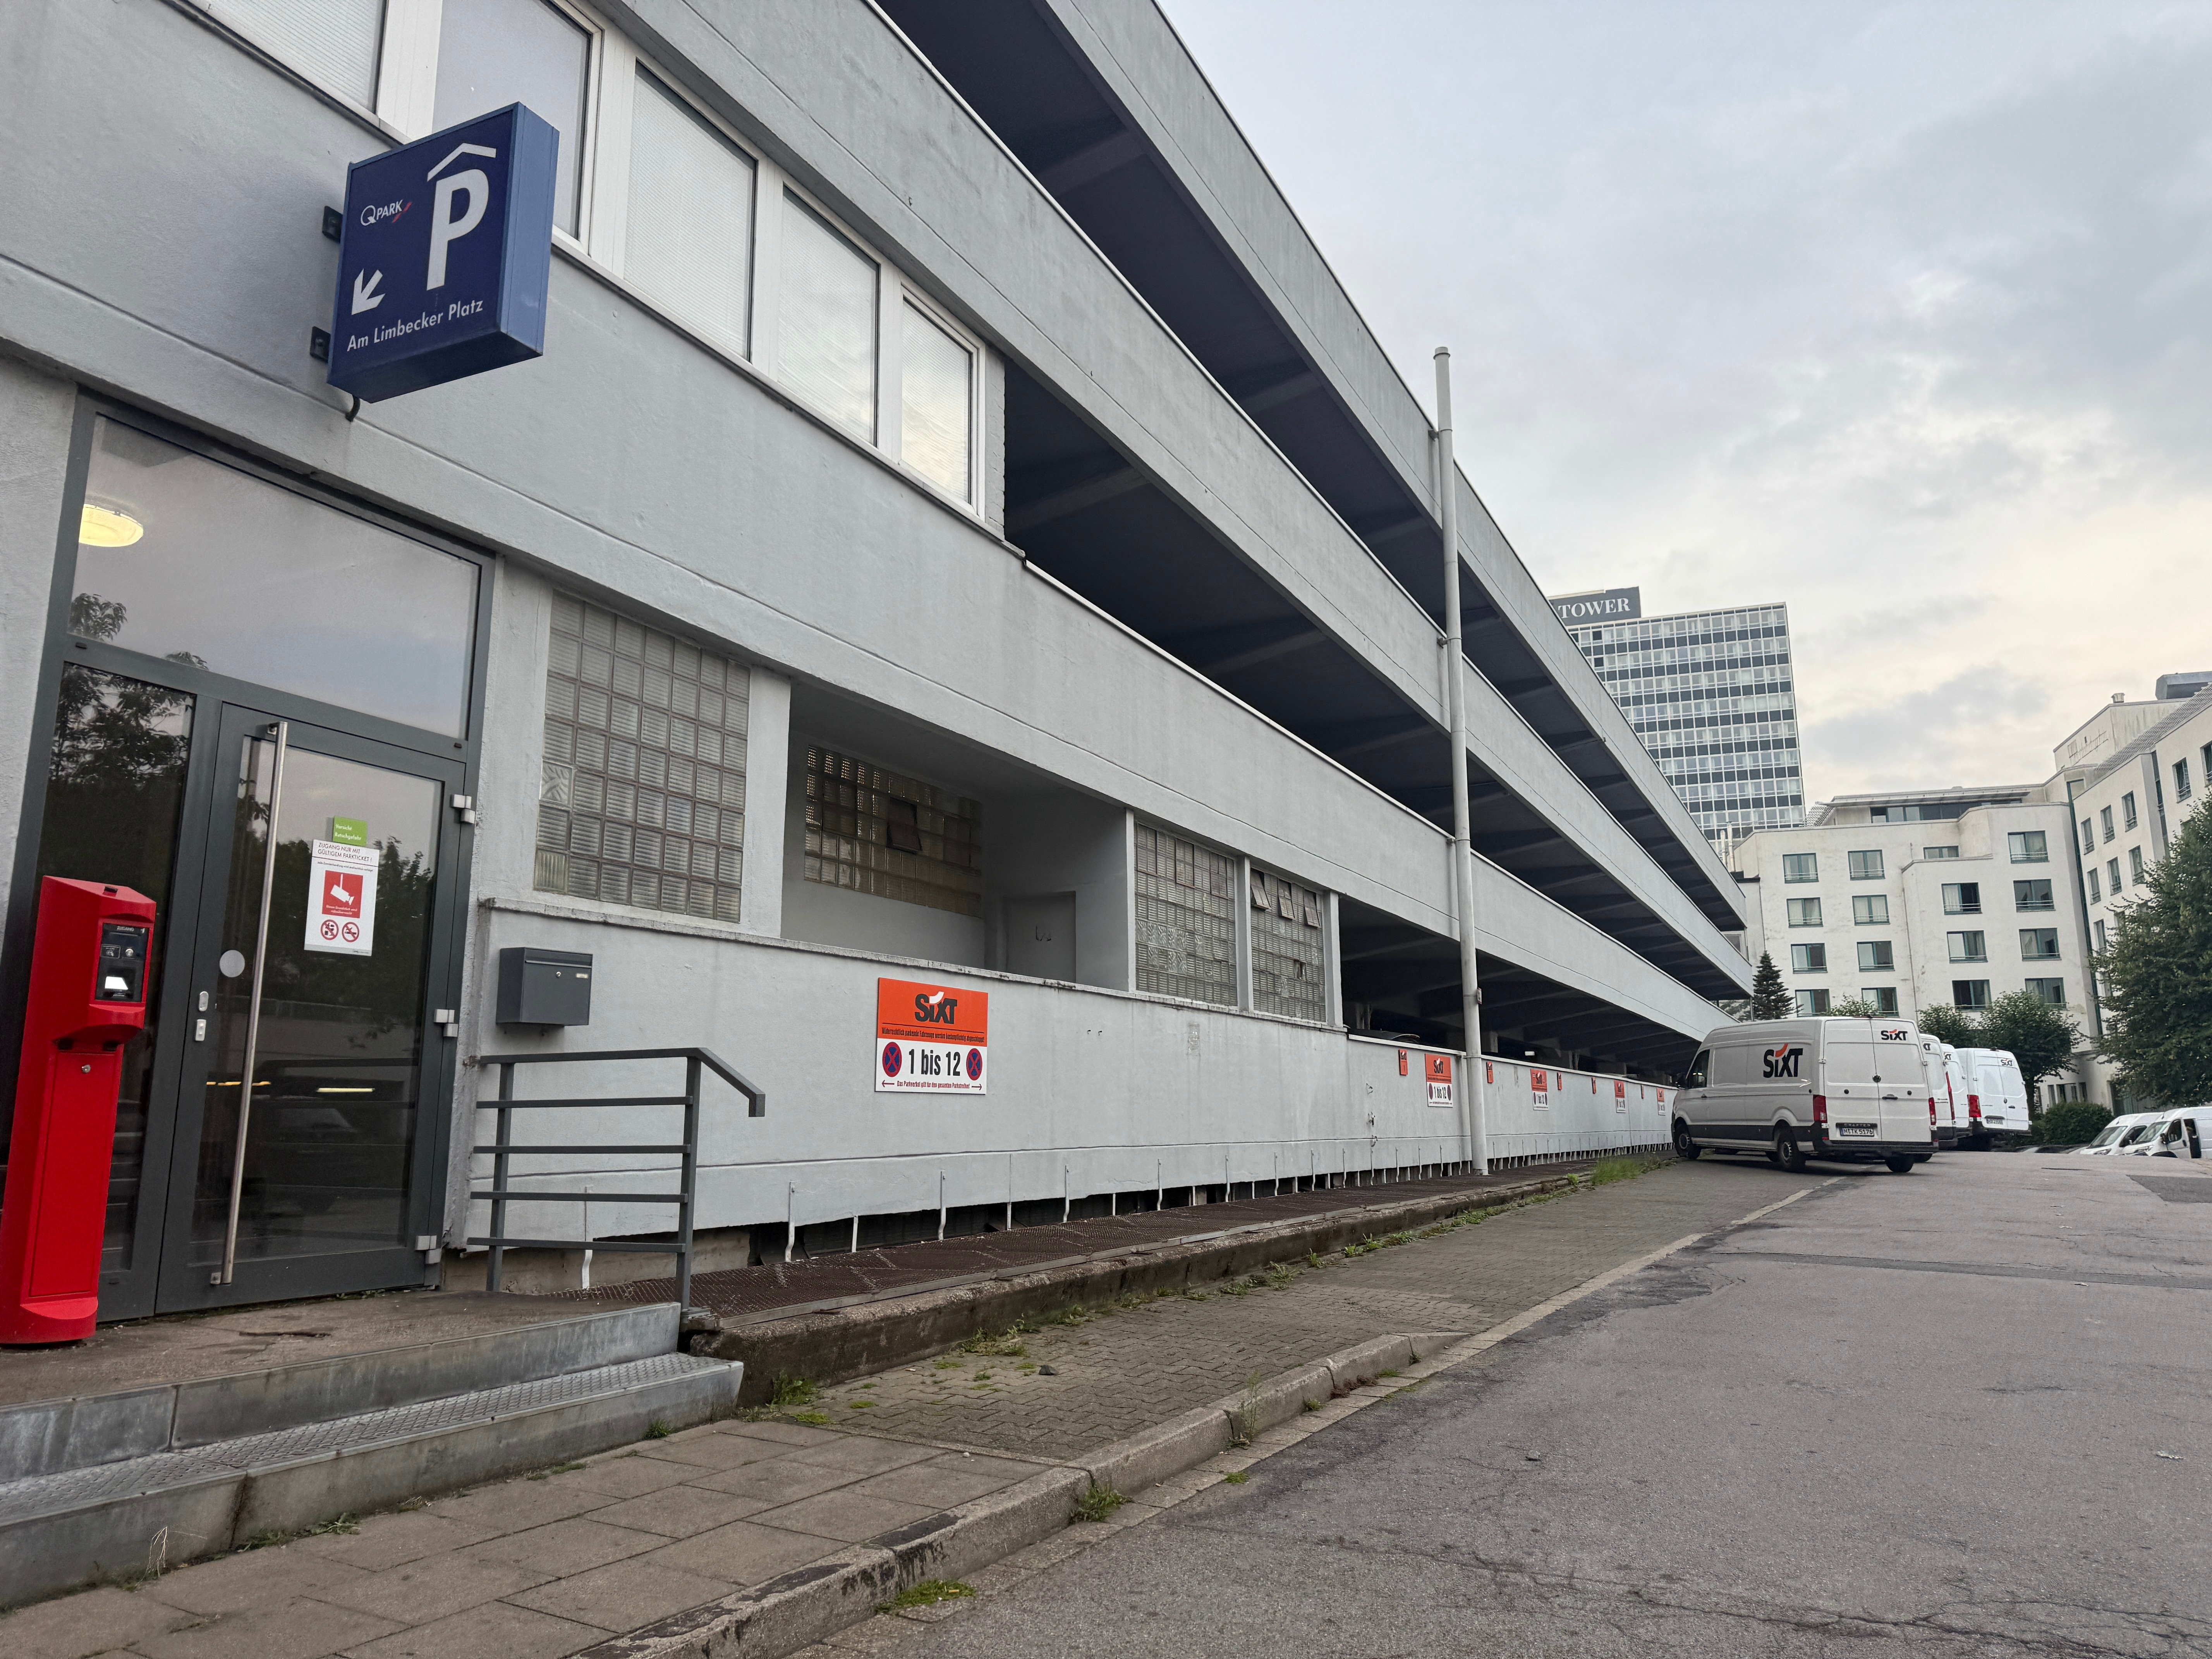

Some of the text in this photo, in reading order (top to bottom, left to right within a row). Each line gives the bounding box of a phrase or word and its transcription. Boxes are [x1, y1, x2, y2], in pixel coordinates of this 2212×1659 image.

[427, 169, 489, 291] P
[347, 301, 483, 352] Am Limbecker Platz
[1558, 598, 1630, 618] TOWER
[318, 849, 342, 857] GÜLTIGEM
[343, 853, 369, 861] PARKTICKET
[909, 1049, 960, 1076] 1 bis 12
